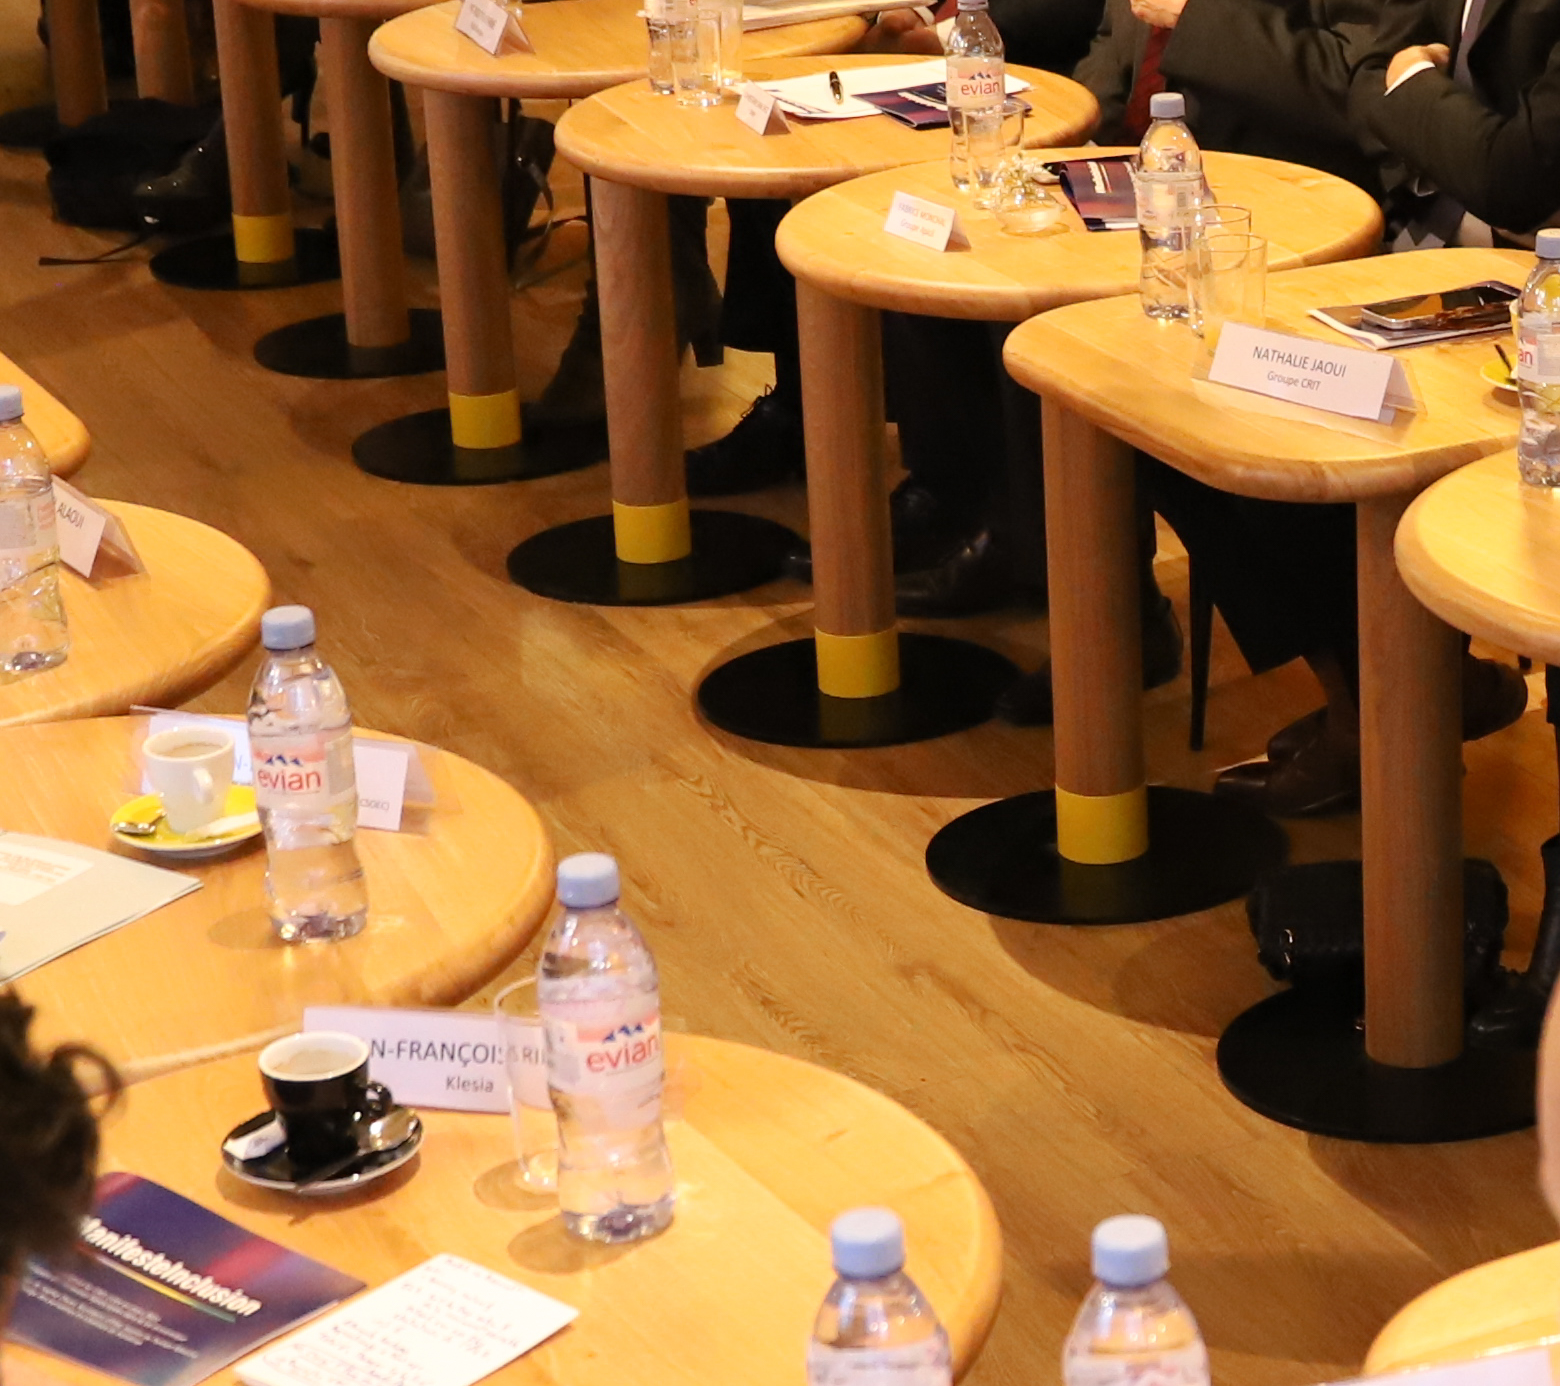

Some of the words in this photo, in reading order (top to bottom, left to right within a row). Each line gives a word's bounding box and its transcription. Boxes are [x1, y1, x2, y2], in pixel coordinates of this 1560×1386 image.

[960, 81, 1000, 96] evian
[1252, 346, 1310, 370] NATHALIE
[1310, 359, 1347, 378] JAOUI
[1267, 370, 1299, 386] Groupe
[1300, 378, 1321, 391] CRIT
[56, 502, 85, 530] ALAOUI
[256, 768, 322, 793] evian
[585, 1032, 659, 1074] evian
[445, 1075, 495, 1094] Klesia
